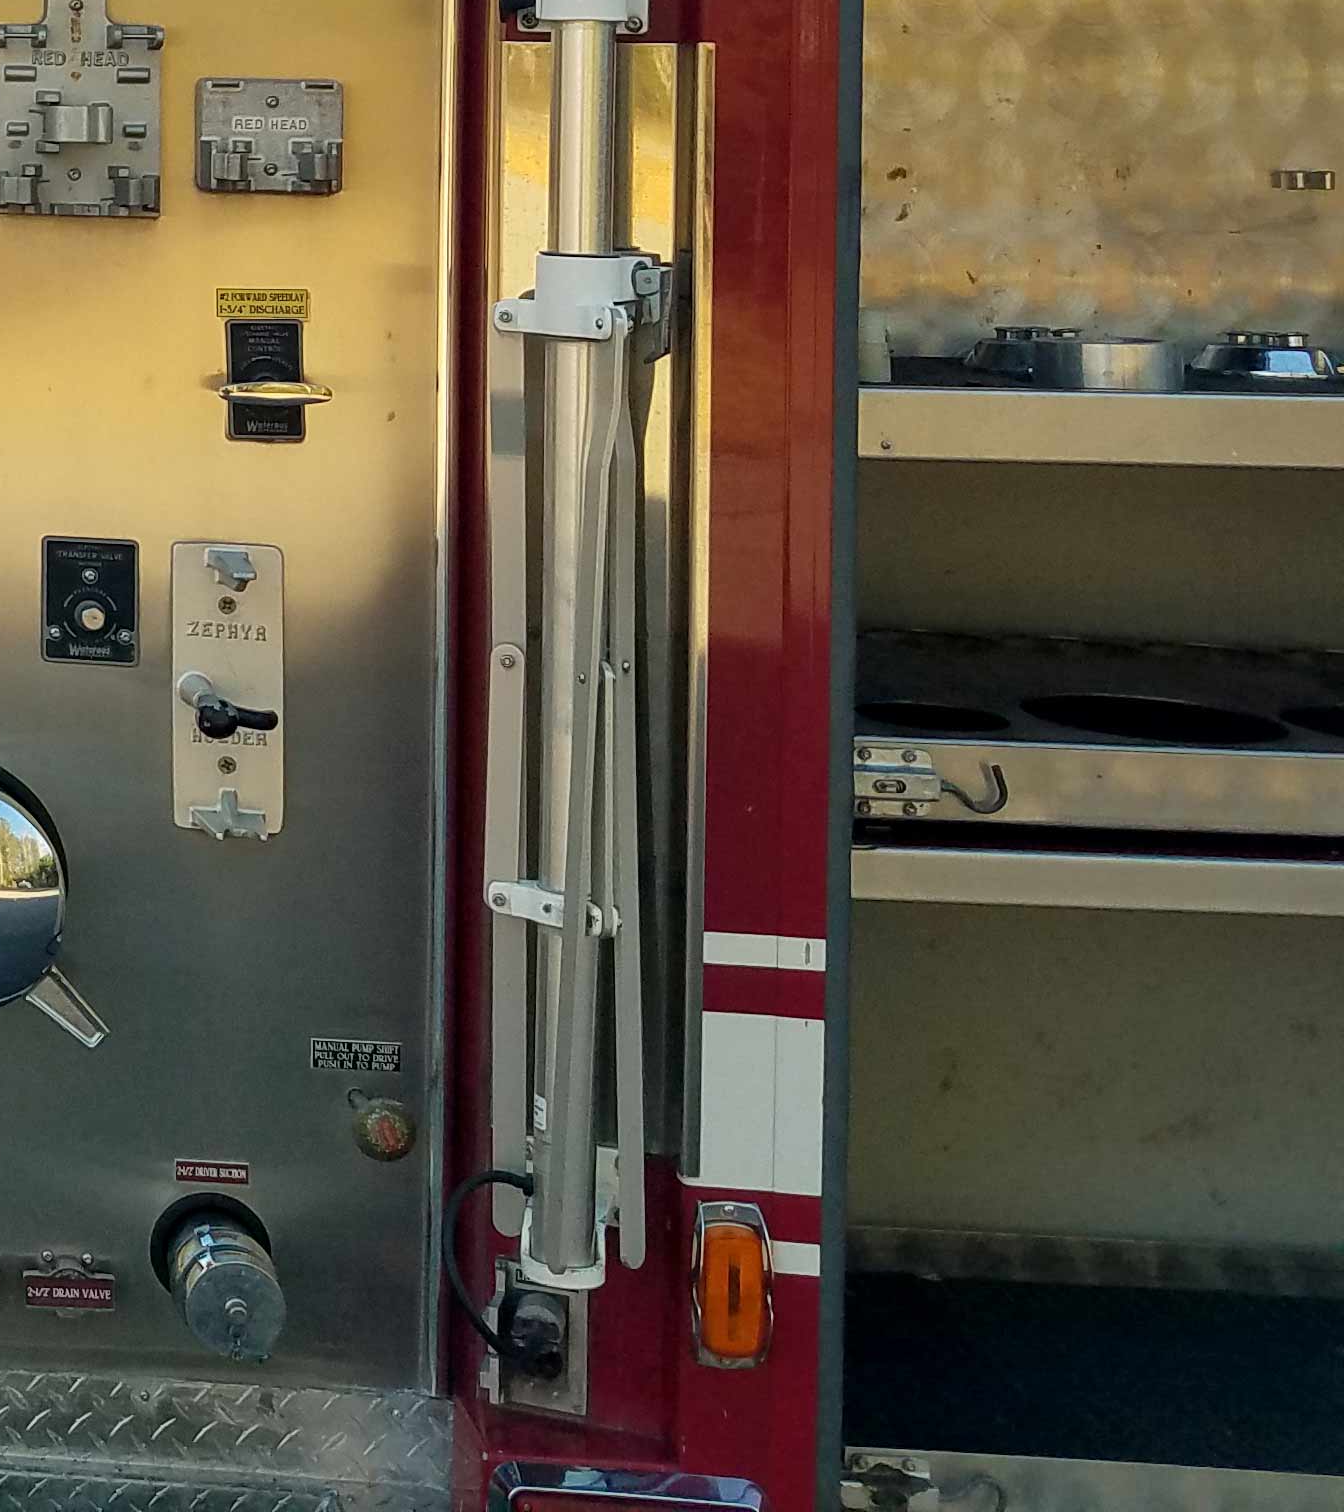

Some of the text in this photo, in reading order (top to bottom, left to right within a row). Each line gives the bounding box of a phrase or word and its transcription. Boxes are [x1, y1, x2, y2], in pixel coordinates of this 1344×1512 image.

[32, 49, 130, 67] RED HEAD
[234, 118, 307, 130] RED HEAD
[249, 305, 304, 314] DISCHARGE
[186, 621, 267, 642] ZEPHYR
[192, 727, 267, 746] HDER
[314, 1041, 399, 1054] MANUAL PUMP SHIFT
[315, 1051, 399, 1063] PULL OUT TO DRIVE
[318, 1059, 395, 1070] PUSH IN TO PUMP
[52, 1287, 80, 1298] DRAIN
[82, 1289, 111, 1300] VALVE
